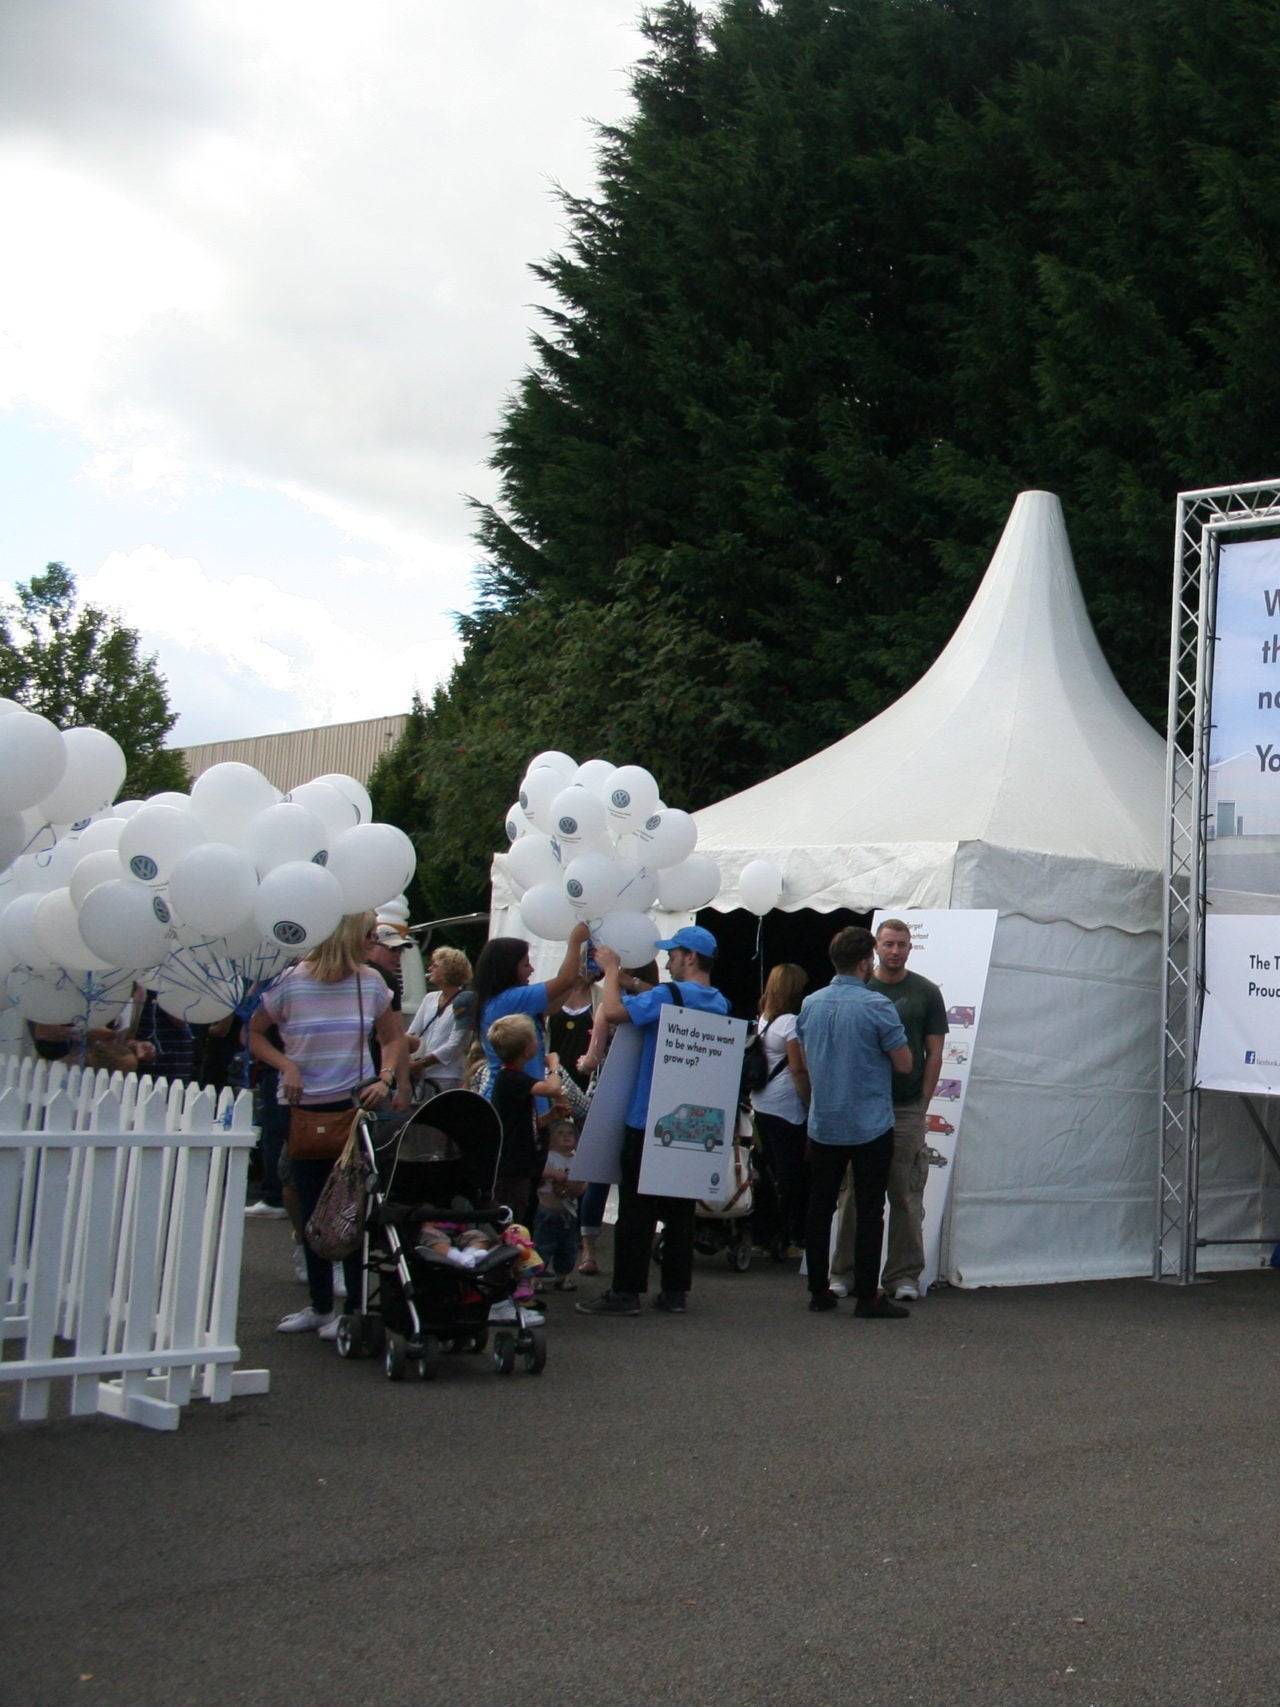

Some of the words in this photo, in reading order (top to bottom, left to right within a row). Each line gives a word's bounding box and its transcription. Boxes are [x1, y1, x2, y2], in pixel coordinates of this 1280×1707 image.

[1249, 955, 1271, 970] The
[668, 1023, 689, 1036] What
[690, 1028, 700, 1038] do
[701, 1032, 714, 1042] you
[716, 1036, 735, 1045] want
[665, 1039, 673, 1048] to
[675, 1039, 685, 1050] be
[686, 1042, 707, 1054] when
[708, 1048, 722, 1057] you
[663, 1054, 683, 1064] grow
[685, 1056, 699, 1067] up?
